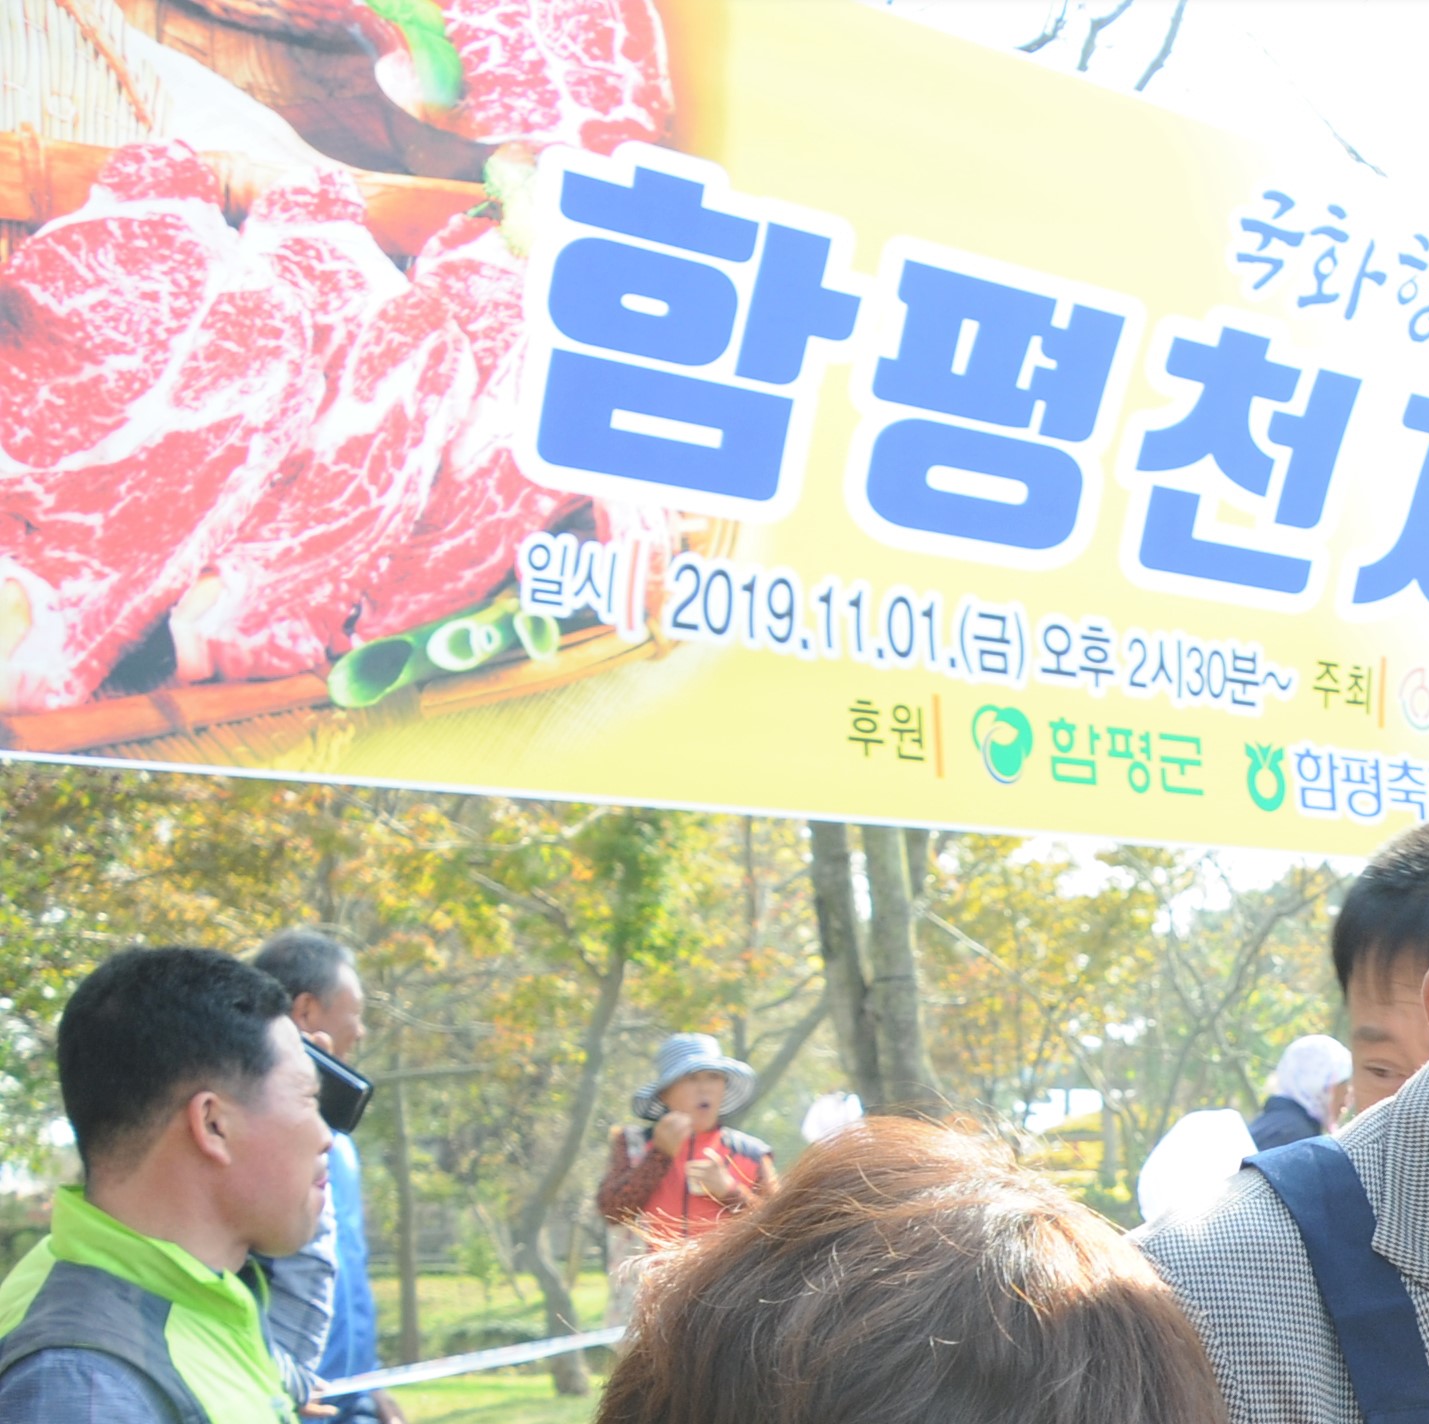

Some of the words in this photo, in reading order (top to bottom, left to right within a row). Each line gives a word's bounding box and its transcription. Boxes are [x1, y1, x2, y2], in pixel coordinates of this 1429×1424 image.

[526, 541, 618, 615] 일시
[670, 562, 1025, 680] 2019.11.01.(금)
[1039, 621, 1116, 688] 오후
[1127, 636, 1292, 708] 2시30분~
[1312, 657, 1376, 714] 주최
[847, 698, 926, 762] 후원
[1047, 715, 1205, 797] 함평군
